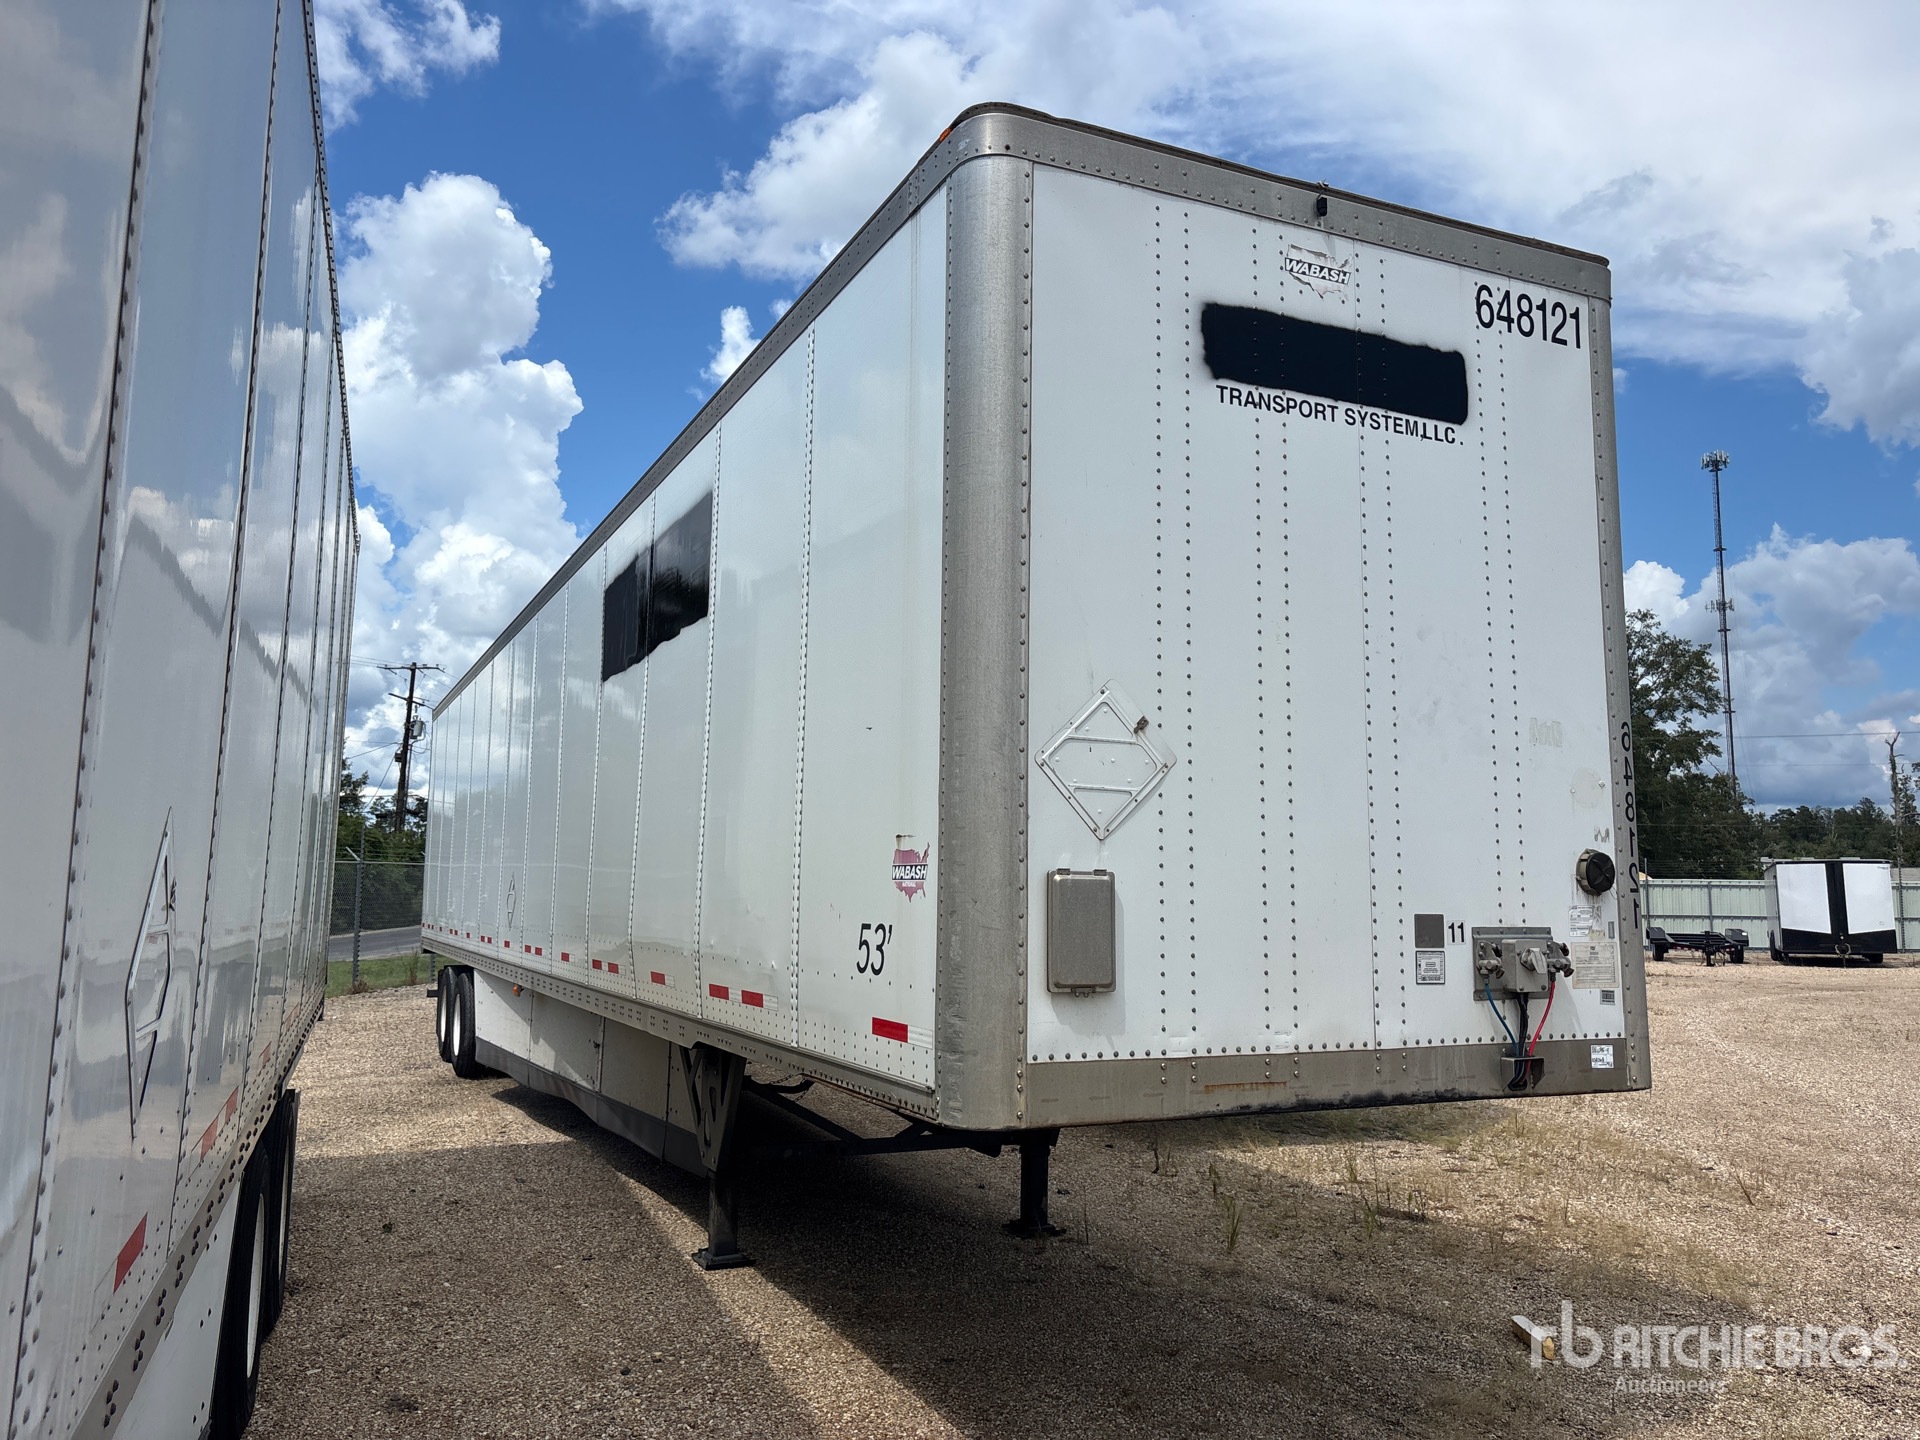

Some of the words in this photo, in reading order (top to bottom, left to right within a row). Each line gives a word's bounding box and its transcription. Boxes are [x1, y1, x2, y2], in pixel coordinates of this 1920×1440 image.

[1286, 258, 1350, 285] WABASH
[1476, 284, 1581, 349] 648121
[1216, 385, 1338, 422] TRANSPORT
[892, 865, 927, 879] WABASH
[1448, 922, 1464, 943] 11
[856, 923, 892, 975] 53'
